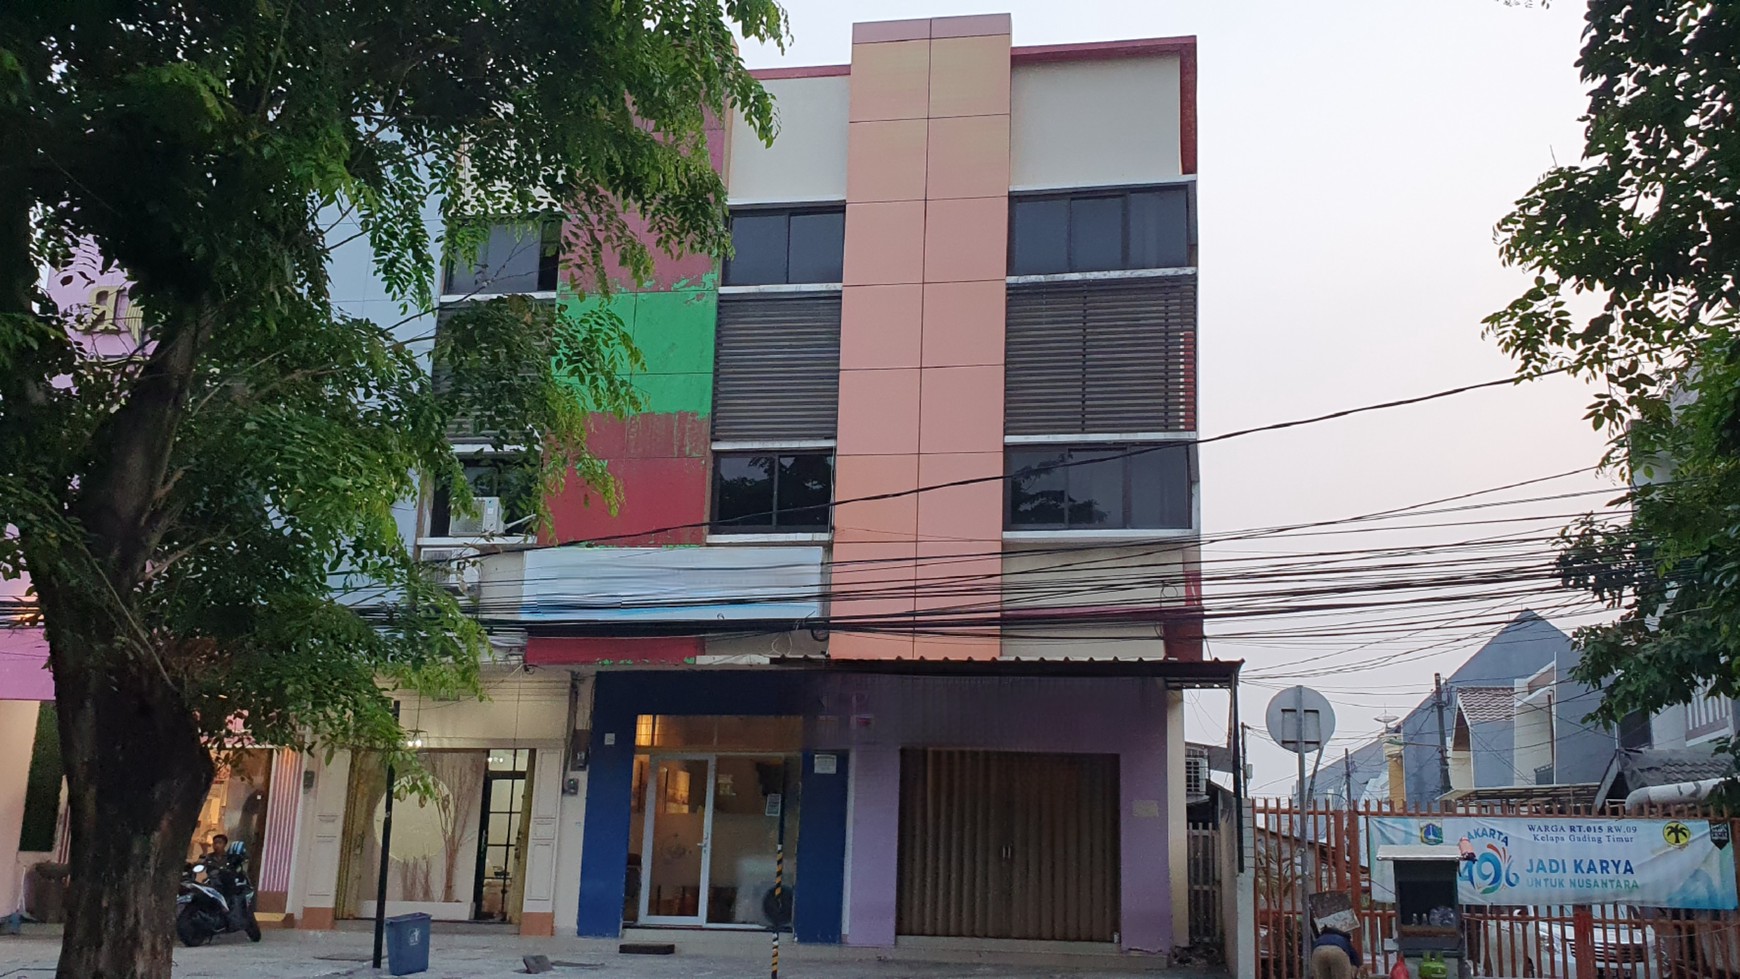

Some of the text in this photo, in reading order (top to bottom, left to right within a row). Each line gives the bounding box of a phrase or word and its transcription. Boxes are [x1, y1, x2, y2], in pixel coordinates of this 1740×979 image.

[1528, 825, 1638, 834] WARGA RT.015 RW.09
[1466, 827, 1509, 847] AKARTA
[1533, 834, 1634, 845] Kelapa Gading Timur
[1458, 852, 1520, 894] 496
[1526, 858, 1635, 875] JADI KARYA
[1527, 878, 1640, 890] UNTUK NUSANTARA
